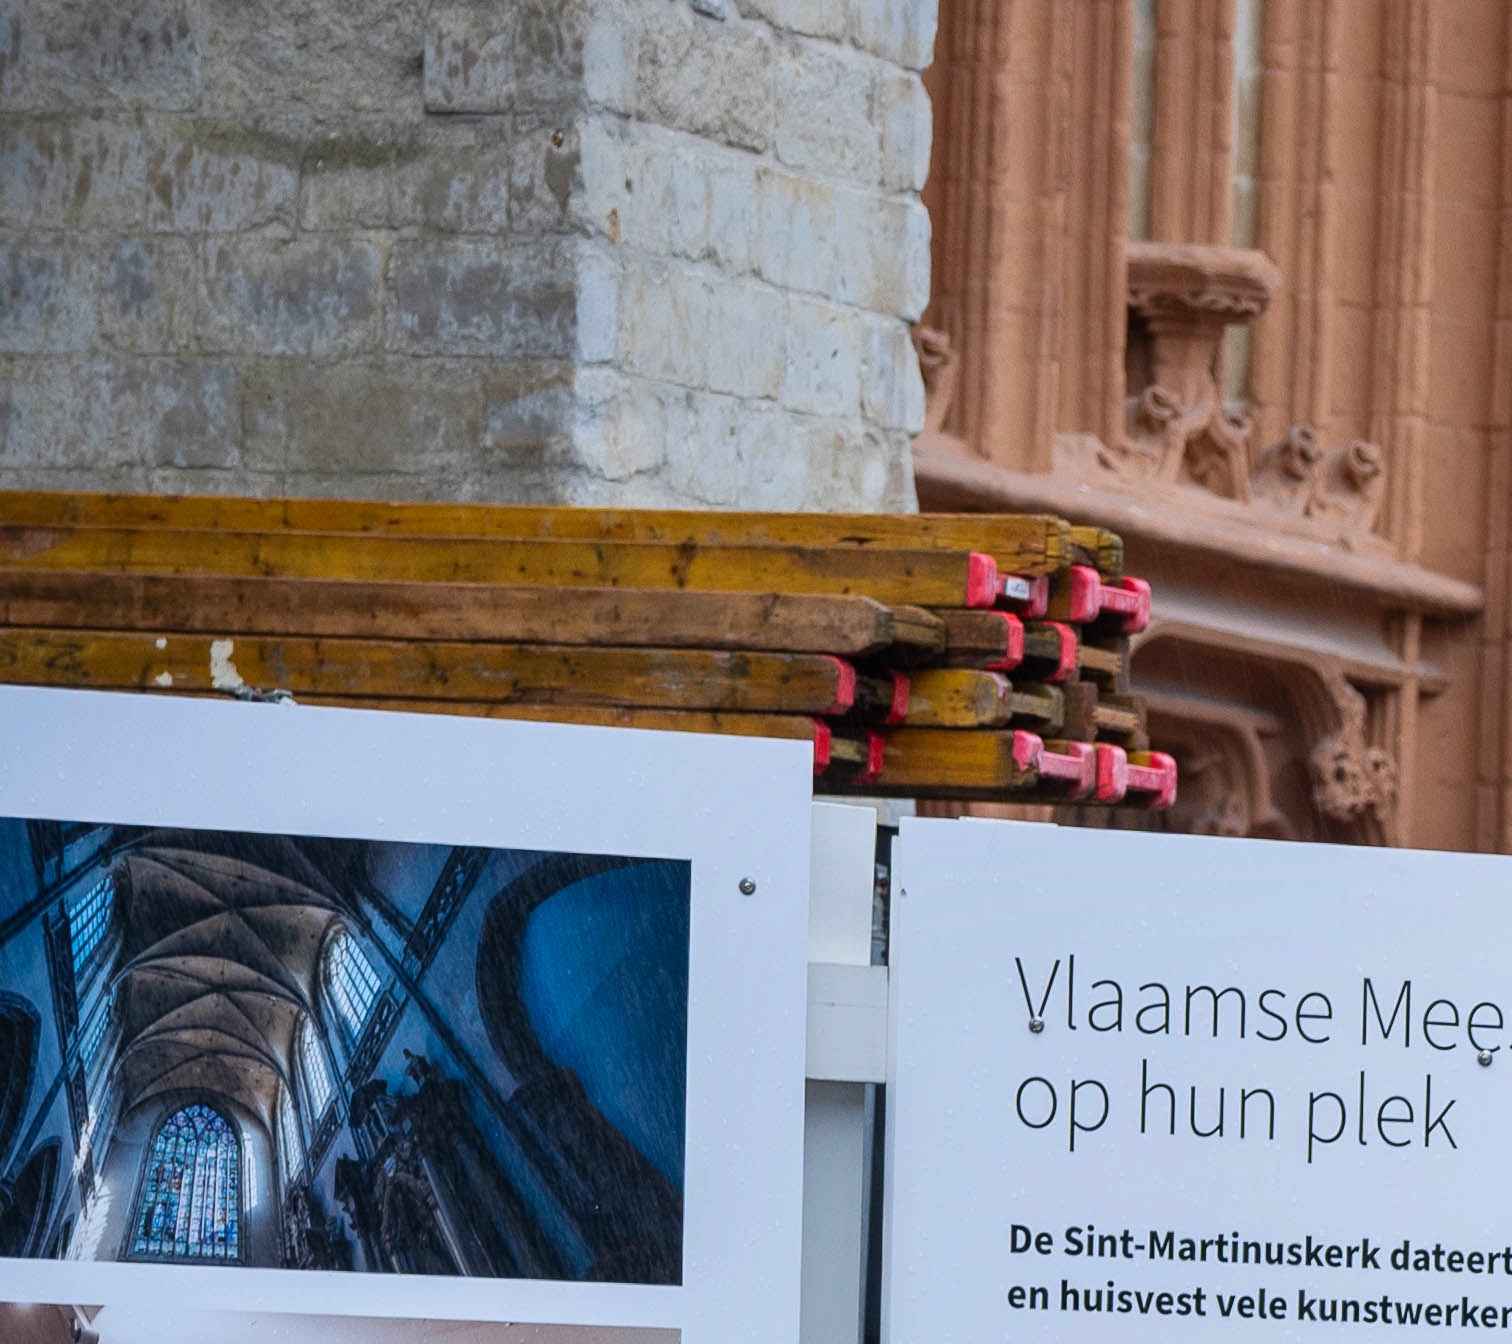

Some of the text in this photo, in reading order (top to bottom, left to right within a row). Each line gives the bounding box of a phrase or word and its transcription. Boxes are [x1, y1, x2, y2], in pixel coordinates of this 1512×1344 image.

[1015, 954, 1332, 1044] Vlaamse
[1016, 1058, 1458, 1164] op hun plek
[1010, 1224, 1053, 1255] De
[1064, 1225, 1381, 1270] Sint-Martinuskerk
[1008, 1286, 1049, 1310] en
[1061, 1279, 1207, 1317] huisvest
[1216, 1288, 1287, 1320] vele
